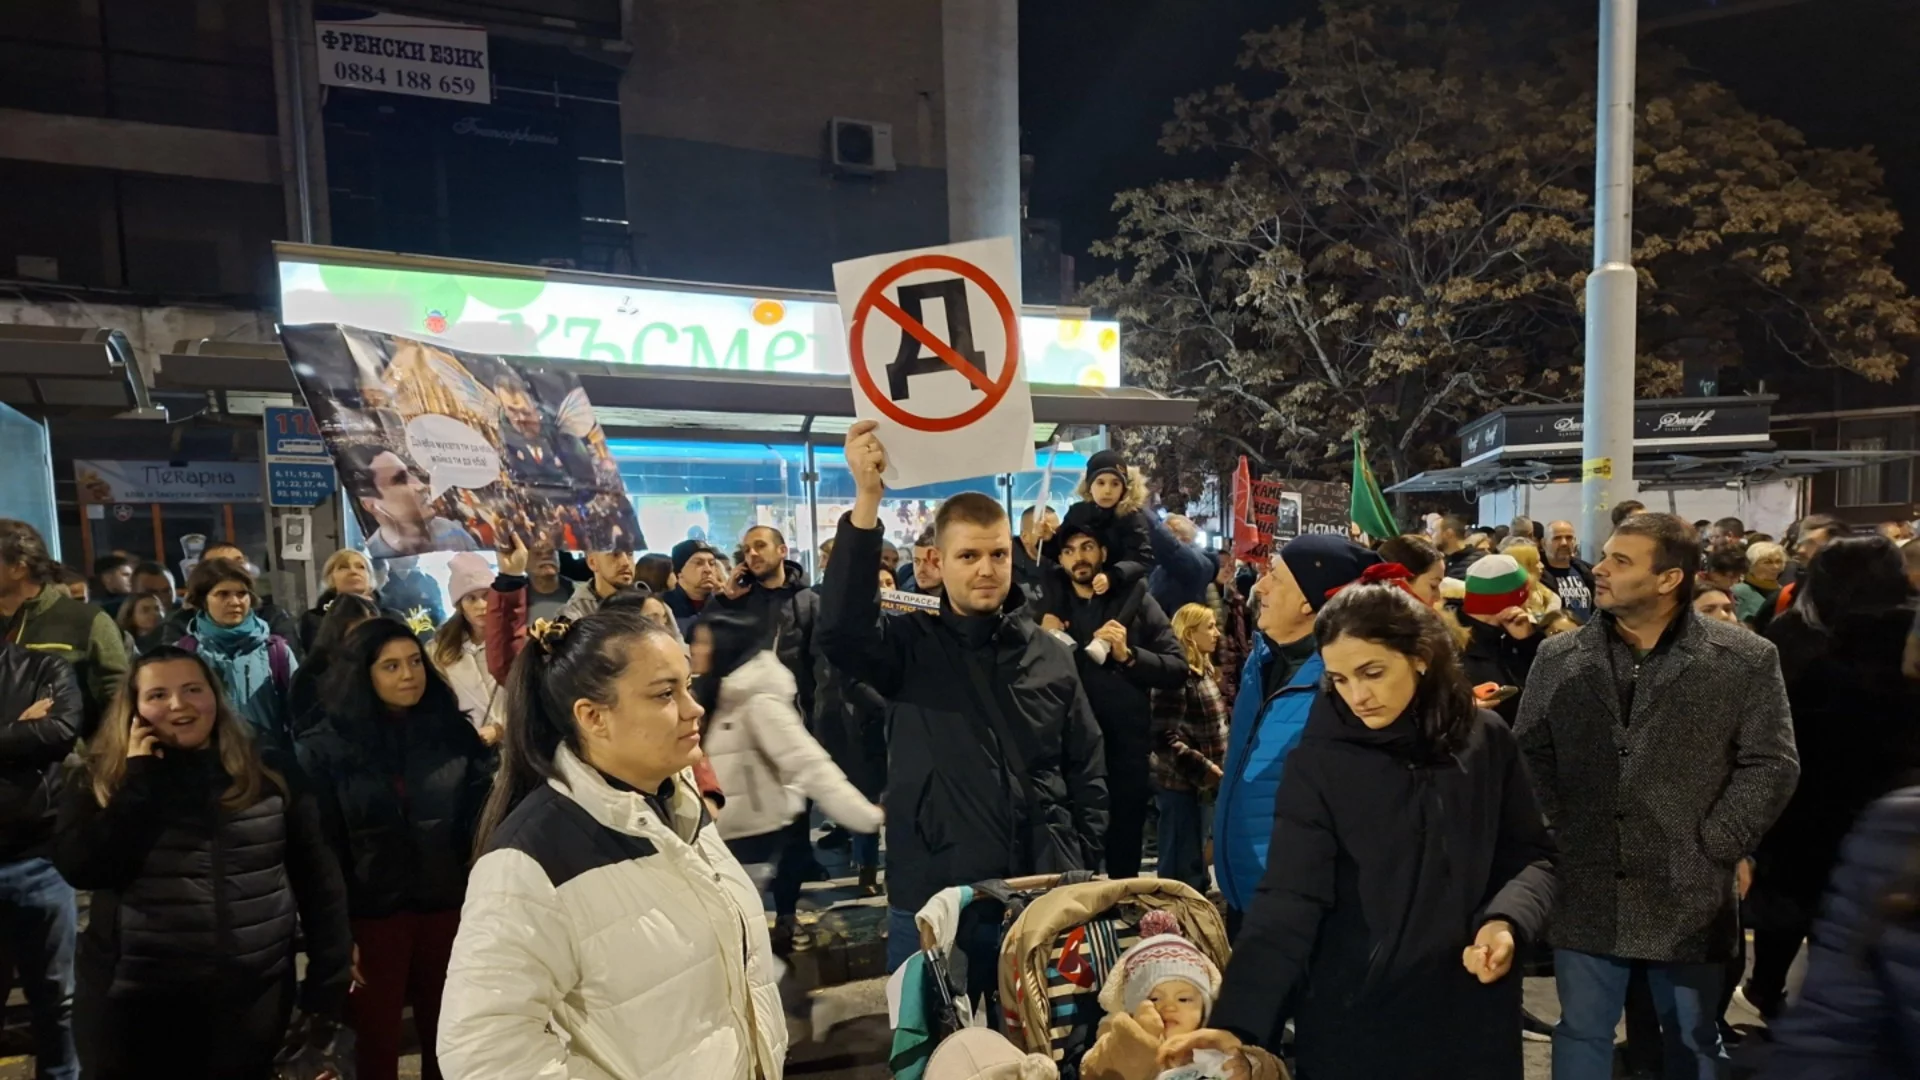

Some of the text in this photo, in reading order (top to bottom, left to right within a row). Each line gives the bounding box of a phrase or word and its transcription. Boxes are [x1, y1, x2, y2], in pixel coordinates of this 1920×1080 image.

[321, 29, 485, 70] ФРЕНСКИ ЕЗИК
[334, 61, 476, 96] 0884 188 659
[885, 277, 988, 402] Д
[141, 465, 236, 488] Пекарна
[1252, 484, 1282, 500] КАМЕ
